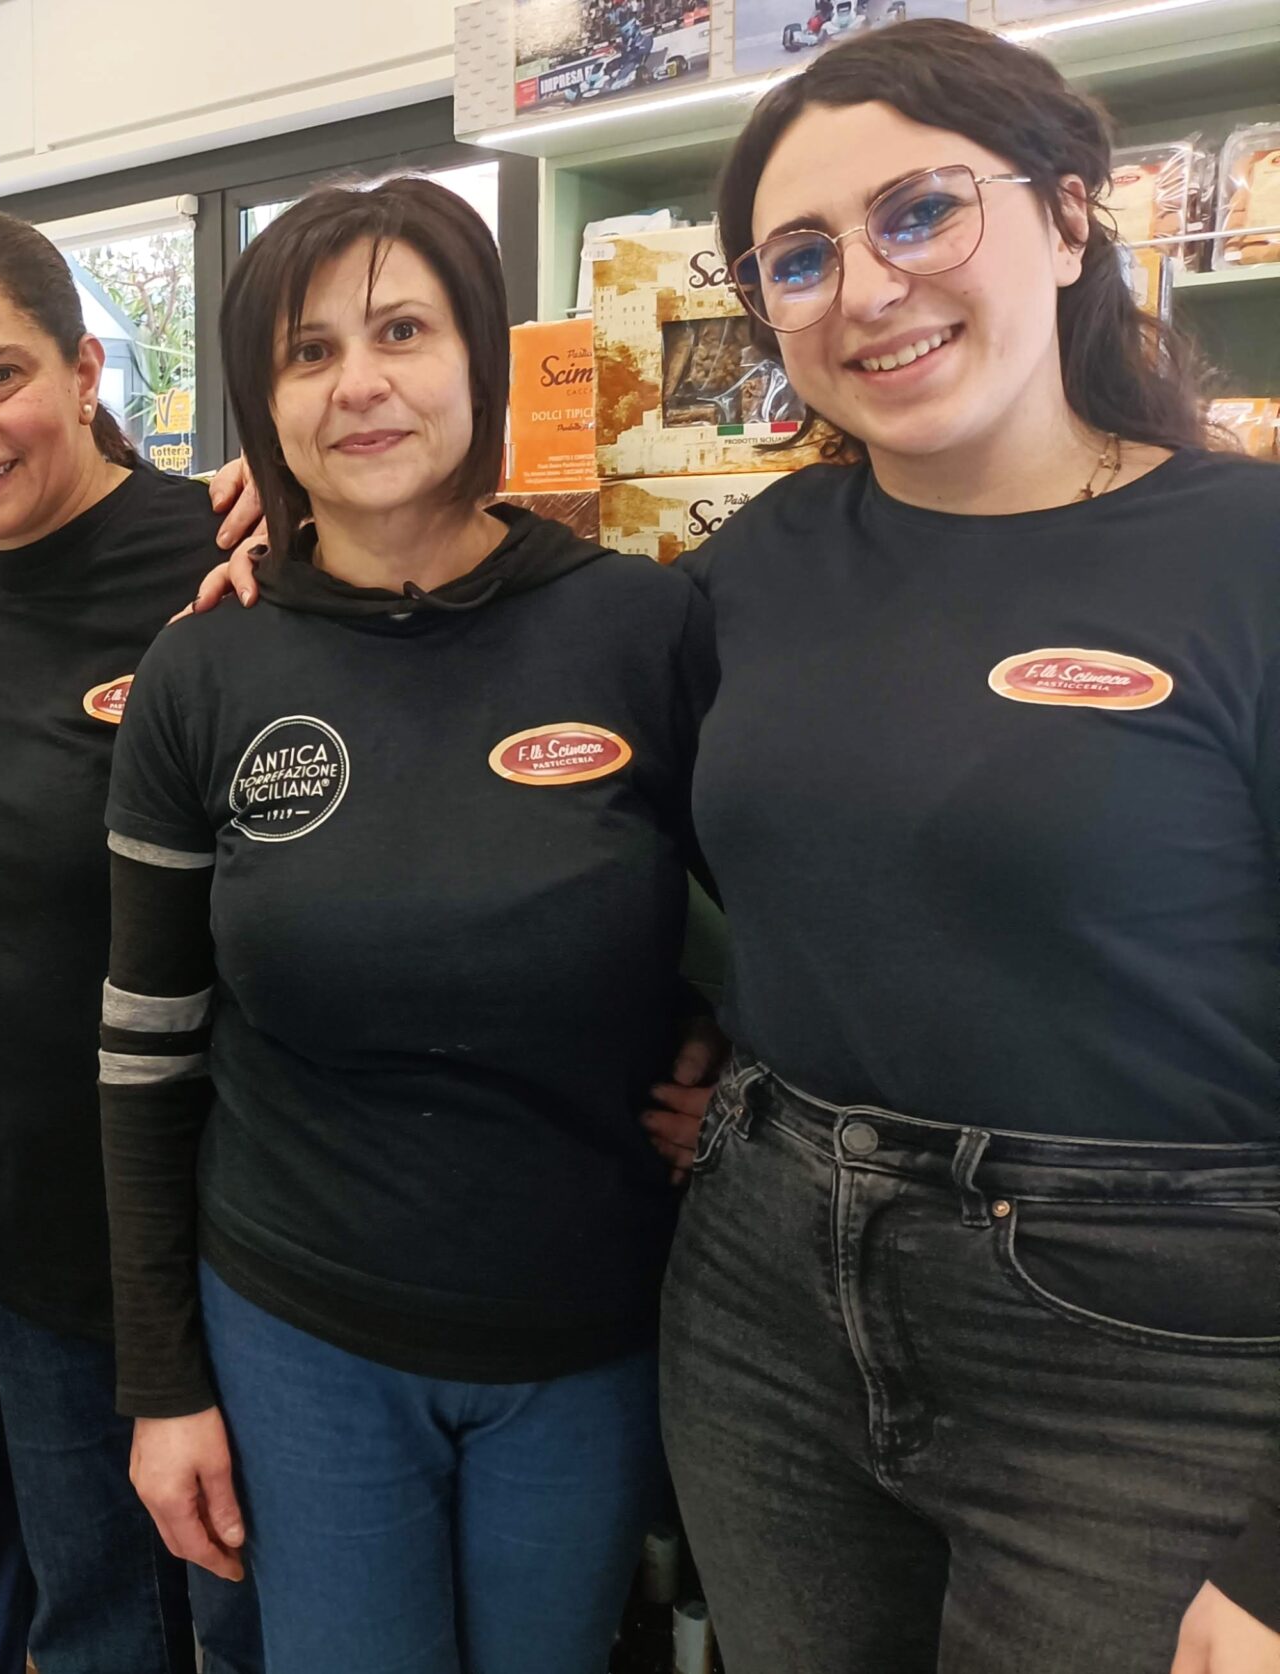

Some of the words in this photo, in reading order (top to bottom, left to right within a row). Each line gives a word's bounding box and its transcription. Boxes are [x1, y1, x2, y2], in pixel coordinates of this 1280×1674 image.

[541, 68, 584, 94] IMPRESA
[532, 410, 562, 422] DOLCI
[151, 445, 191, 457] Lotteria
[157, 457, 187, 468] Italia
[1058, 664, 1131, 686] Scimeca
[1035, 680, 1110, 692] PASTICCERIA
[546, 739, 604, 758] Scimeca
[251, 743, 328, 776] ANTICA
[532, 756, 594, 770] PASTICCERIA
[239, 763, 338, 792] TORREFAZIONE
